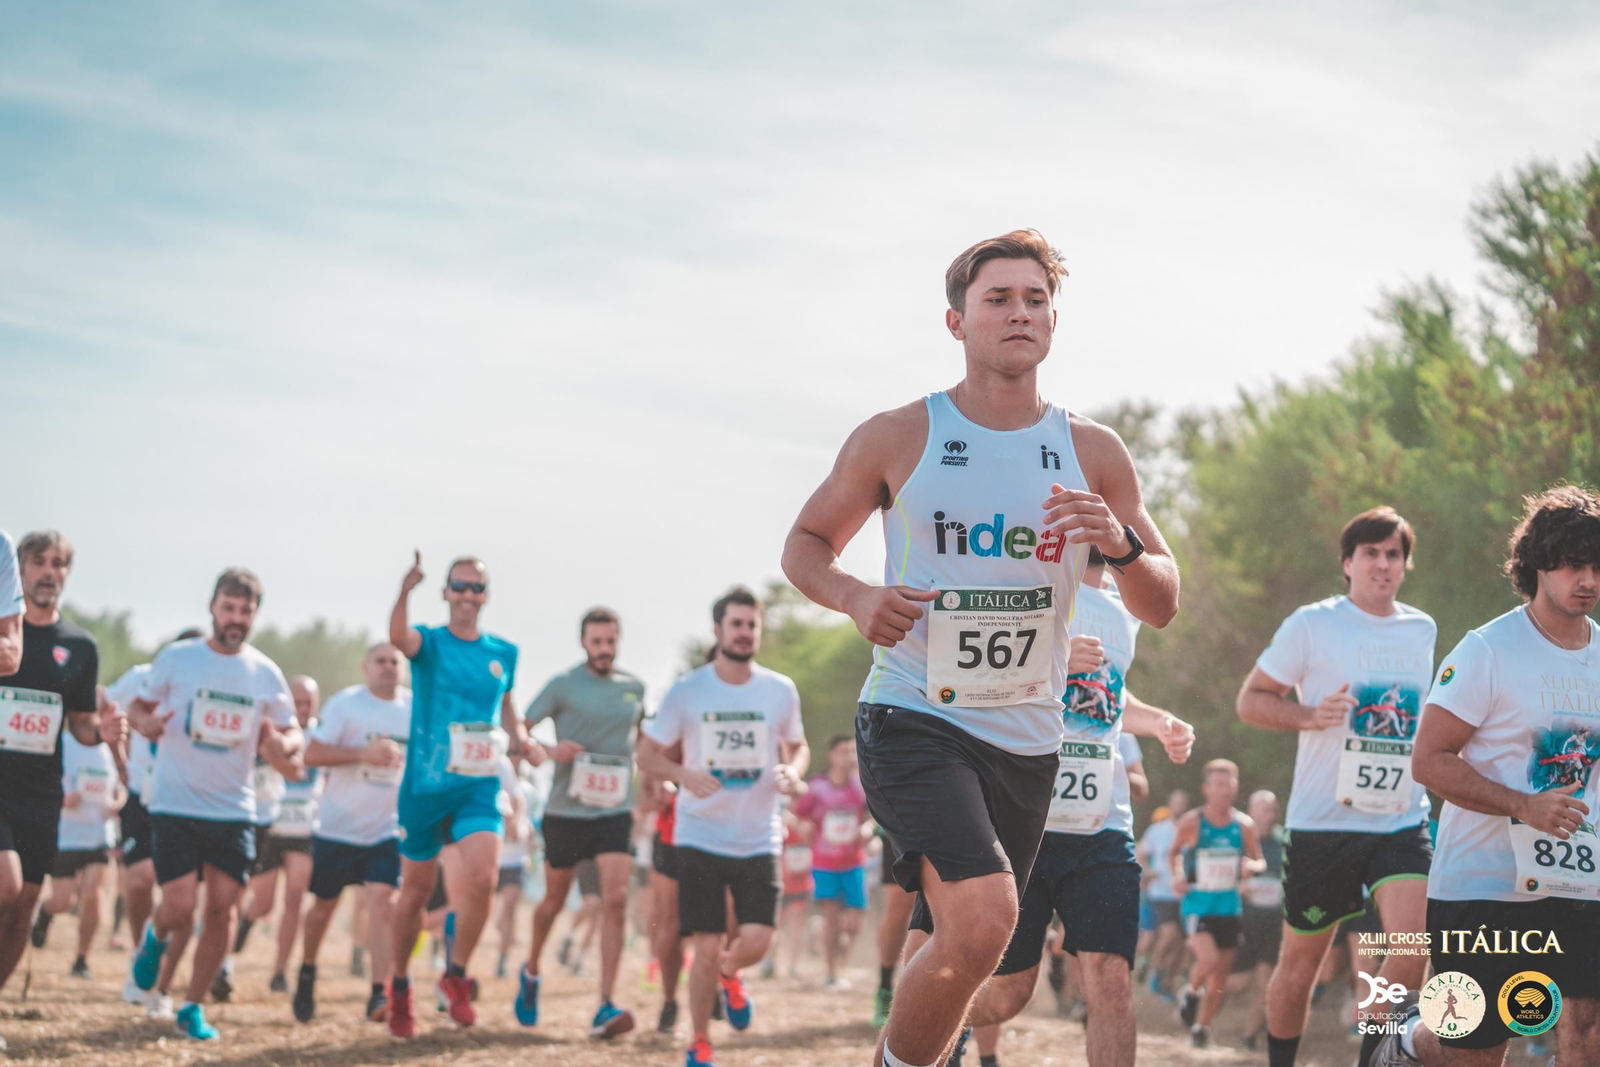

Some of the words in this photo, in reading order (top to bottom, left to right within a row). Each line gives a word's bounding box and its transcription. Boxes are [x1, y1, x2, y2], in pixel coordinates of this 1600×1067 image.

[934, 510, 1067, 564] indea
[968, 591, 1030, 607] ITÁLICA
[957, 629, 1037, 669] 567
[8, 711, 51, 735] 468
[204, 709, 242, 733] 618
[715, 730, 756, 750] 794
[1356, 765, 1404, 791] 527
[1534, 839, 1596, 873] 828
